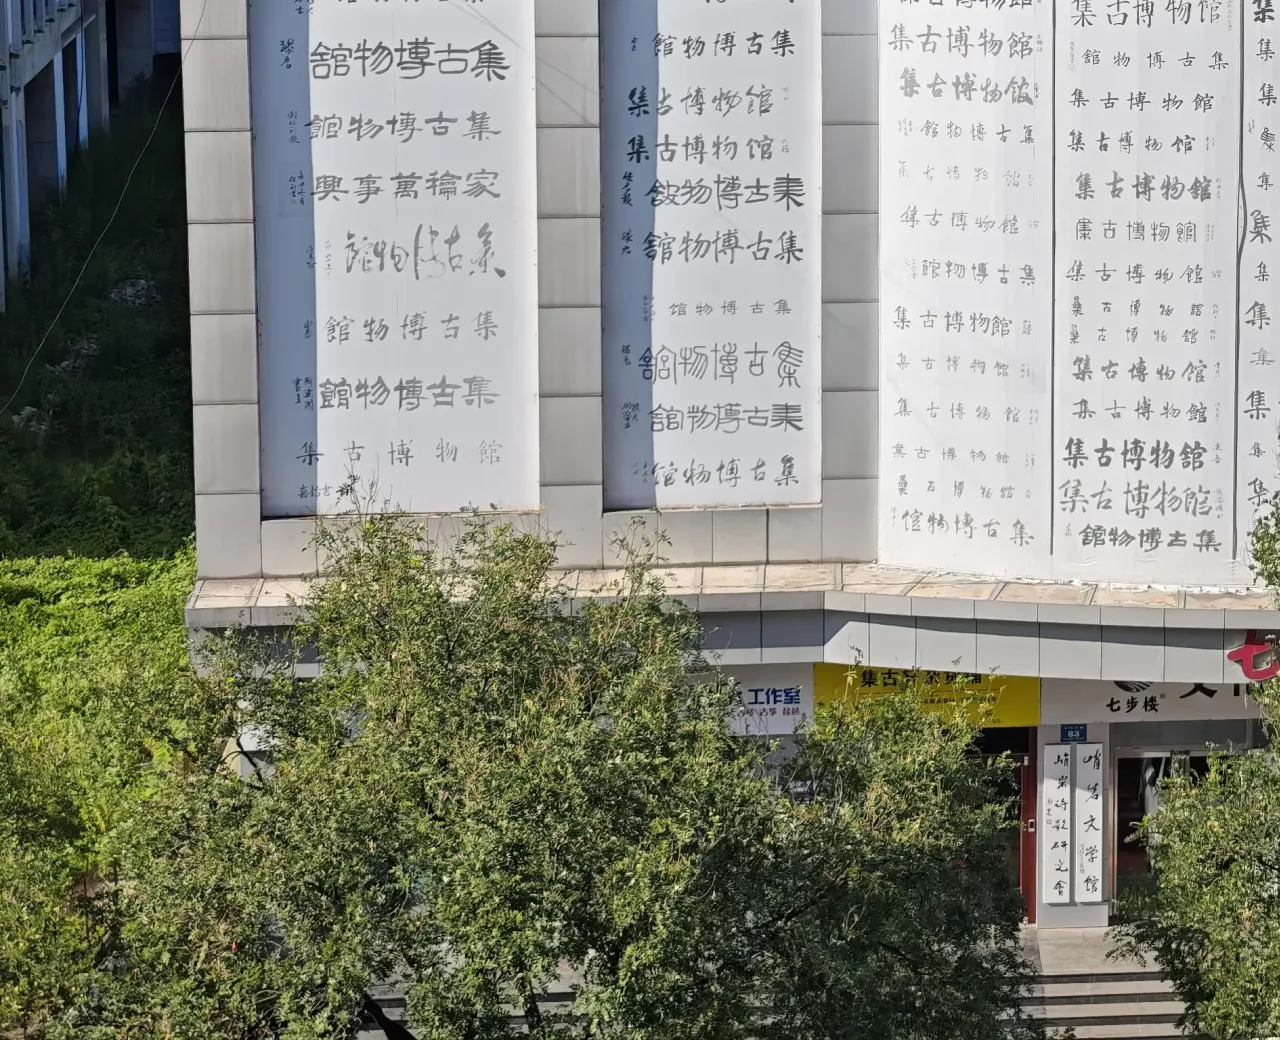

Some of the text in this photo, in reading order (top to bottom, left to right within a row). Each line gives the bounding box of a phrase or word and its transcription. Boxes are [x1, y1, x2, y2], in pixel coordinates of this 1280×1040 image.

[747, 688, 801, 705] 工作室
[1106, 697, 1160, 713] 七步楼
